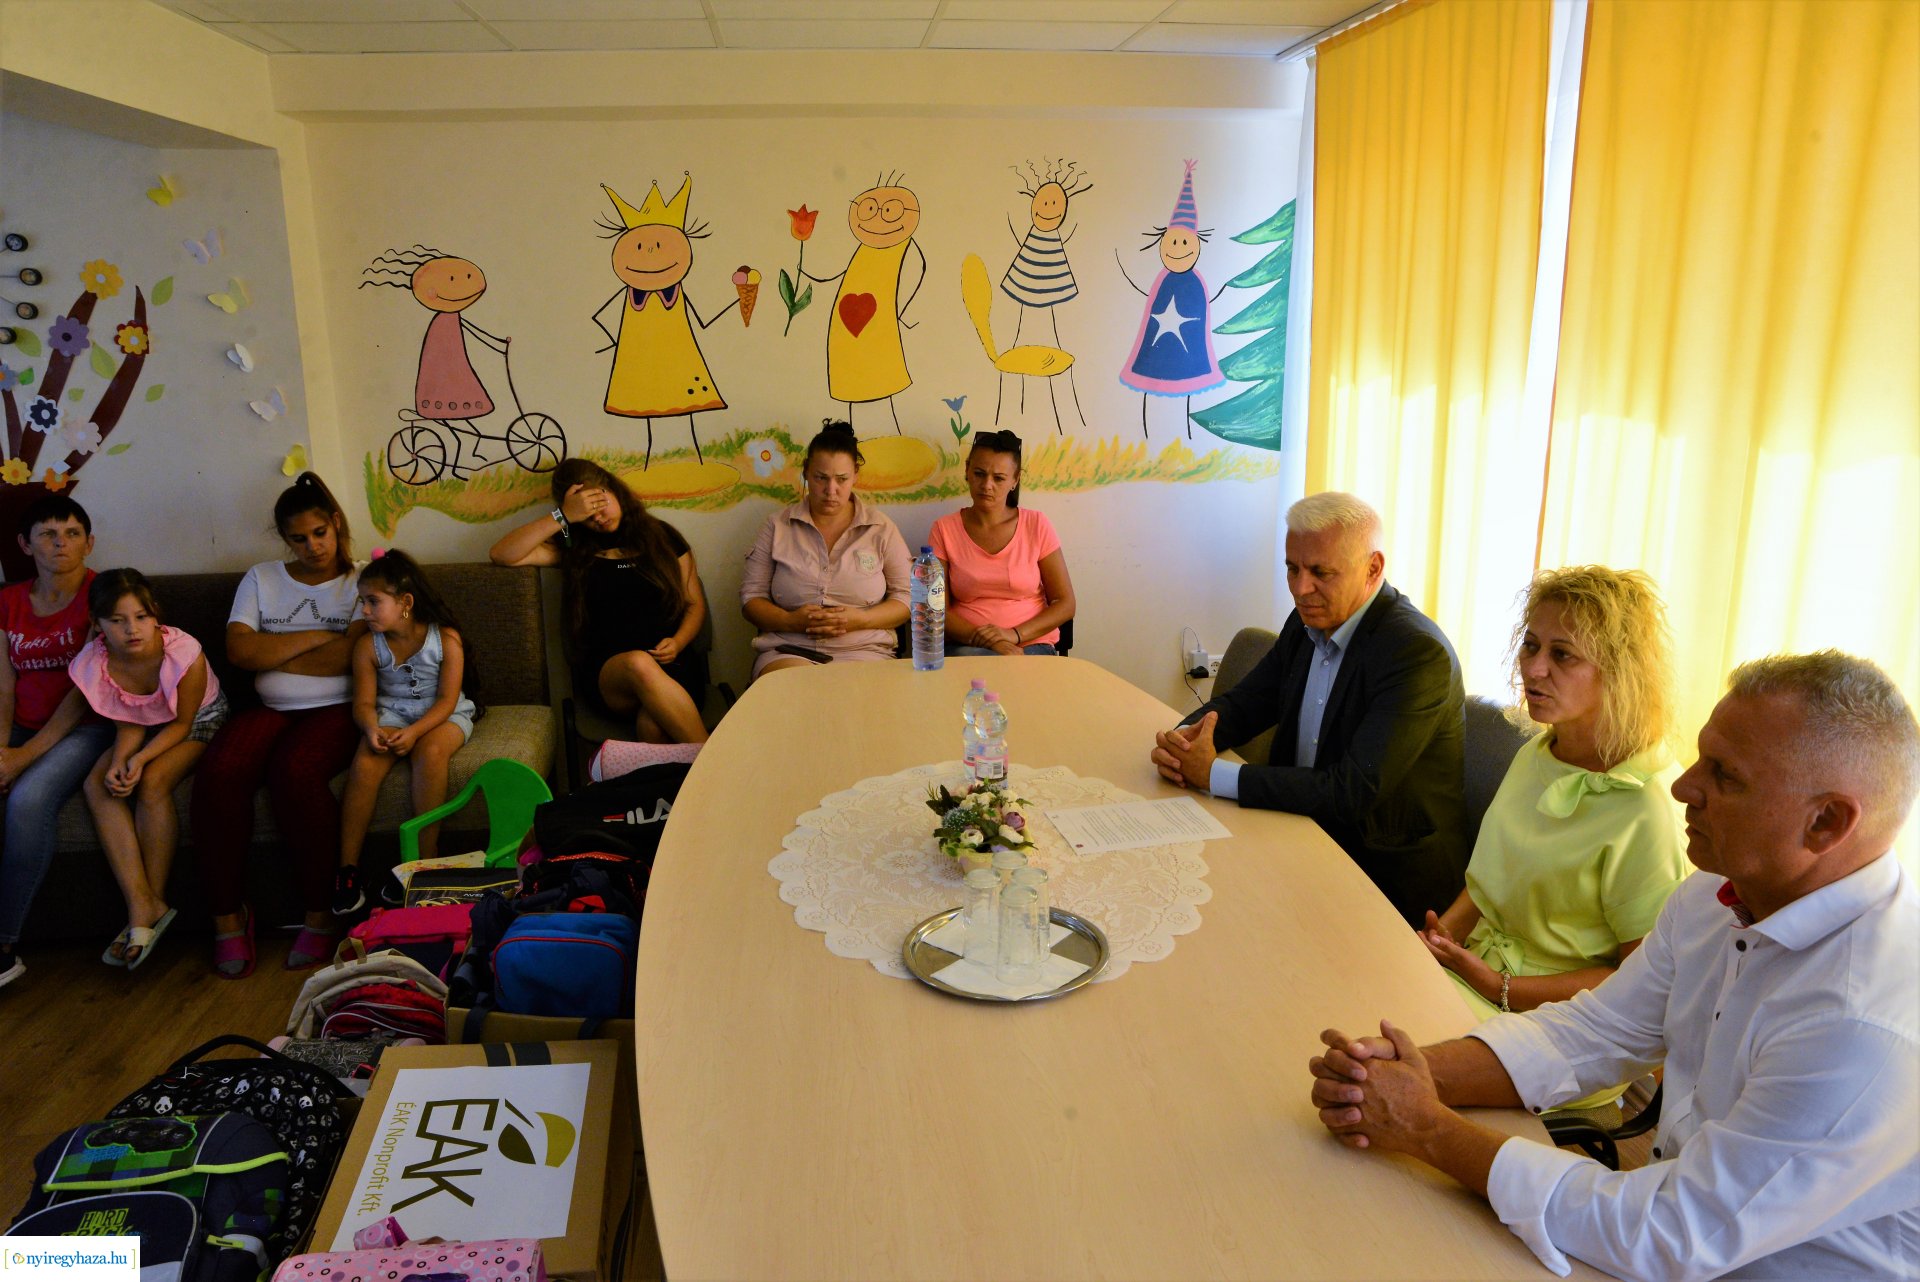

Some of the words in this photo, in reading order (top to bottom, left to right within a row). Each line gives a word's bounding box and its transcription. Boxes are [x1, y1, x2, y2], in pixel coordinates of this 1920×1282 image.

[320, 616, 351, 625] FAMOU
[60, 627, 74, 646] it
[367, 1129, 405, 1189] Nonprofit
[357, 1193, 383, 1216] Kft.
[80, 1209, 129, 1230] HARD
